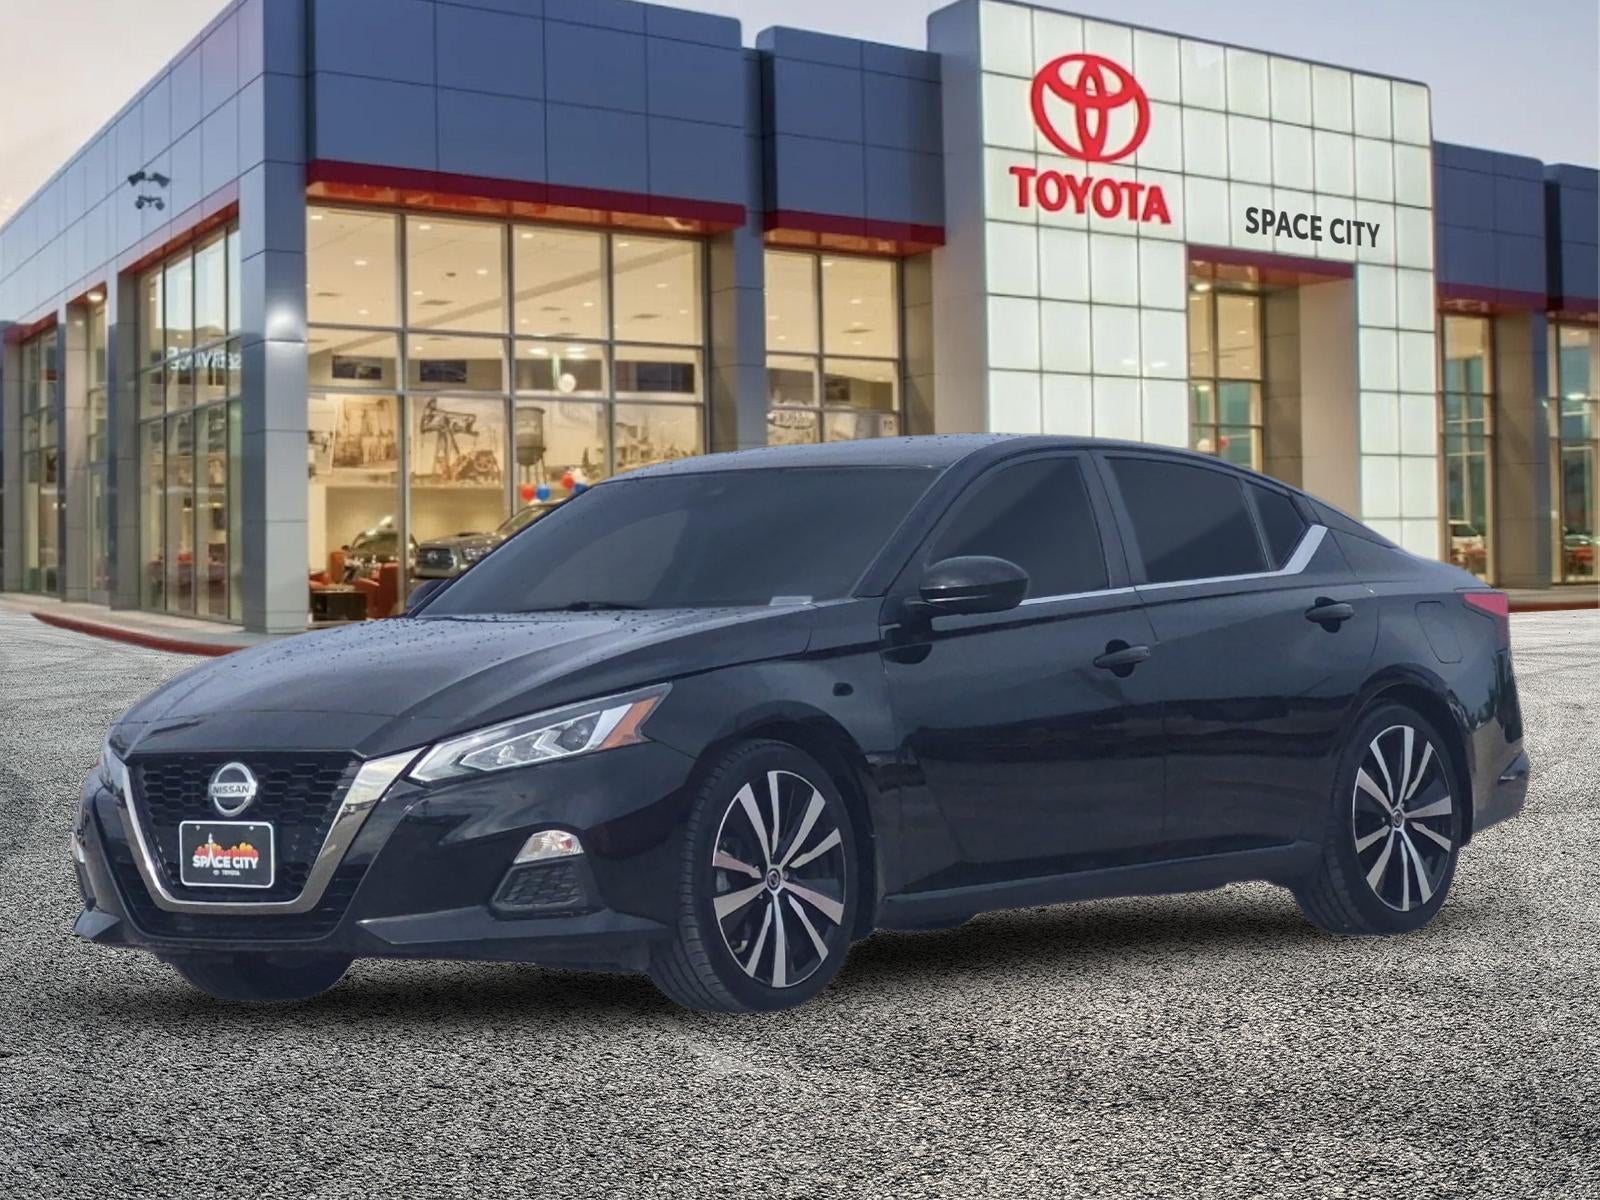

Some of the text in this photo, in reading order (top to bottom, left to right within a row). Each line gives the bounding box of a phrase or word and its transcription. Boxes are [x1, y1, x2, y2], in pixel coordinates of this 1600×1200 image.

[1009, 166, 1171, 224] TOYOTA
[1245, 206, 1381, 248] SPACE CITY
[212, 784, 250, 794] NISSAN
[192, 855, 259, 869] SPACE CITY
